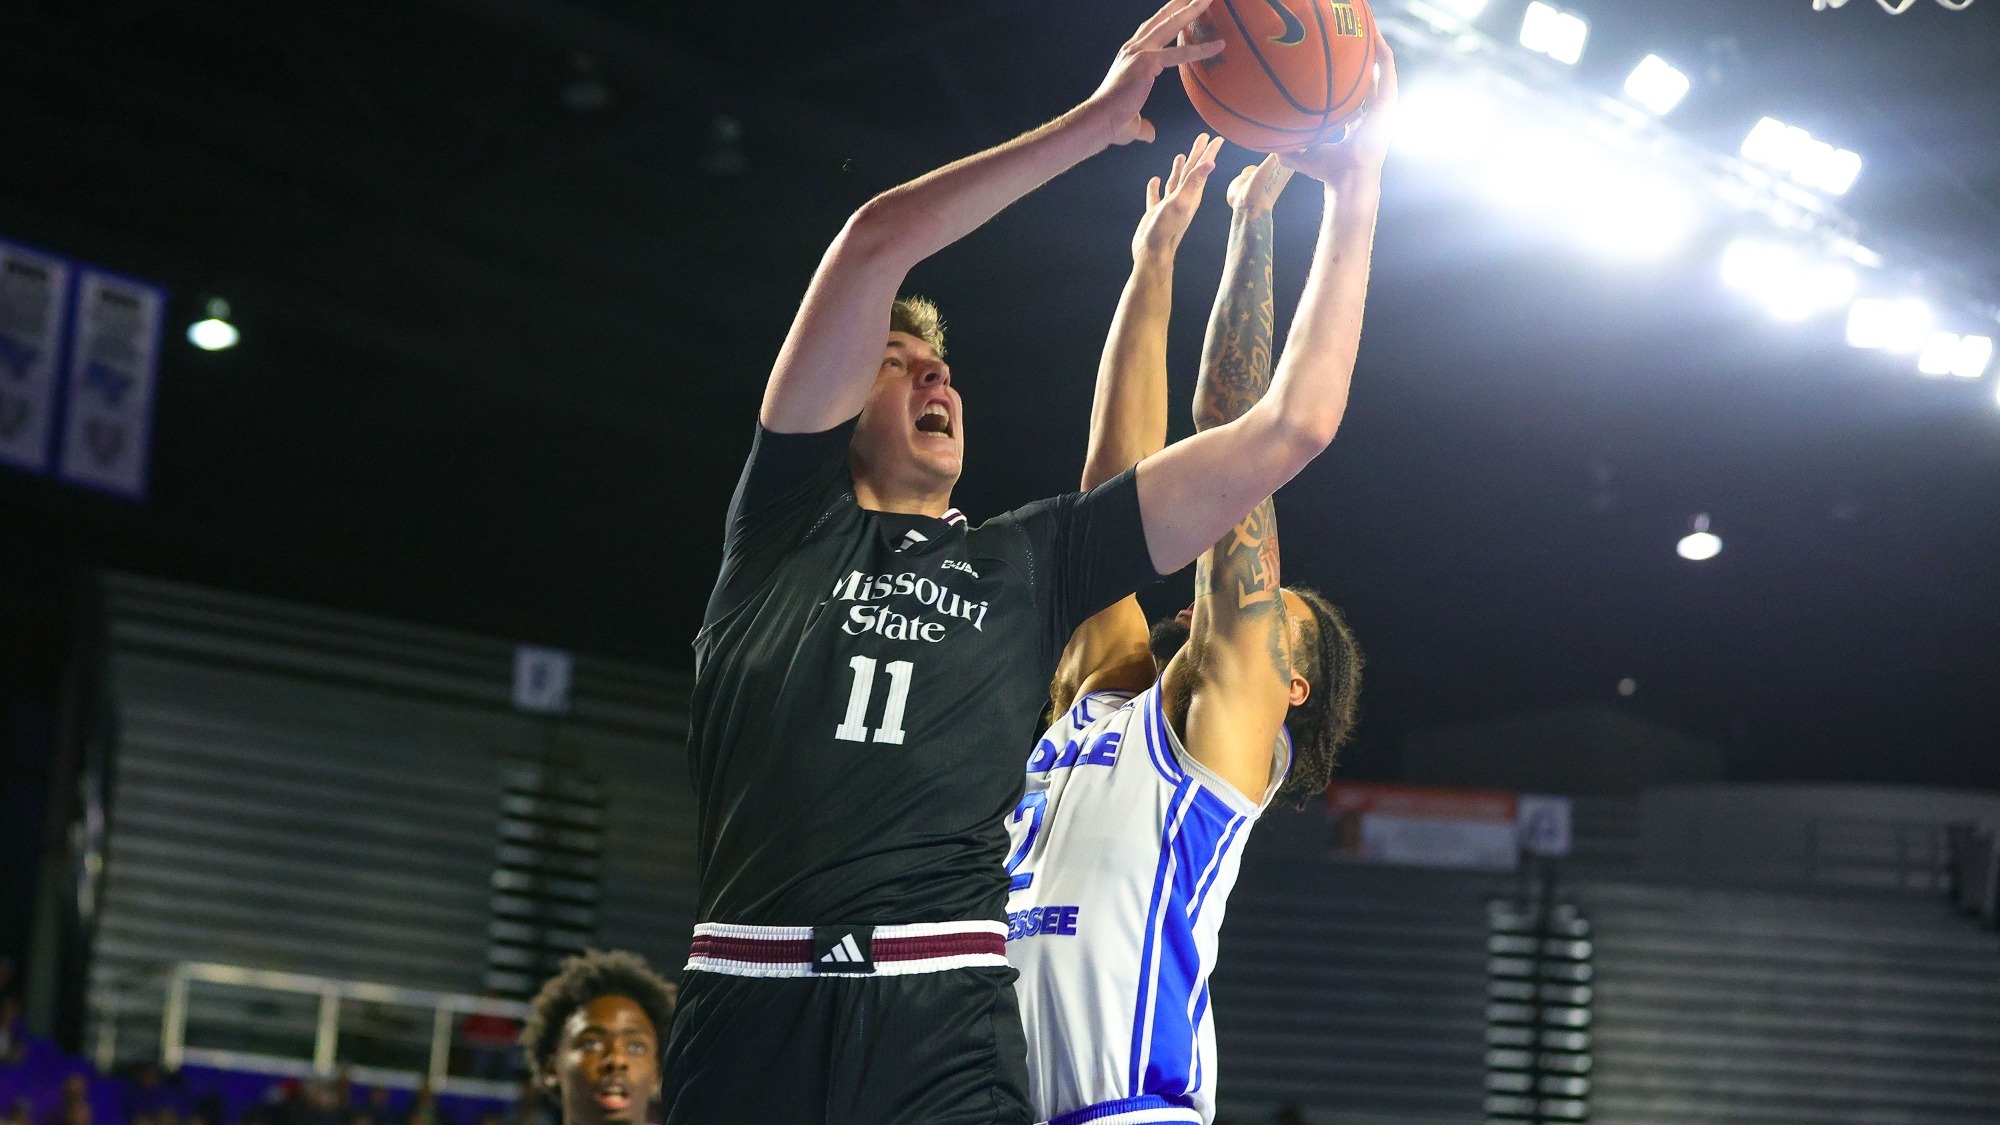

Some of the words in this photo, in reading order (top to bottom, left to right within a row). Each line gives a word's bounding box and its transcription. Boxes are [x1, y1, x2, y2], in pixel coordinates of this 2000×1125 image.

[820, 569, 989, 632] Missouri
[841, 604, 946, 643] State
[834, 654, 914, 745] 11
[1026, 732, 1122, 773] DDLE
[1007, 906, 1080, 941] ESSEE
